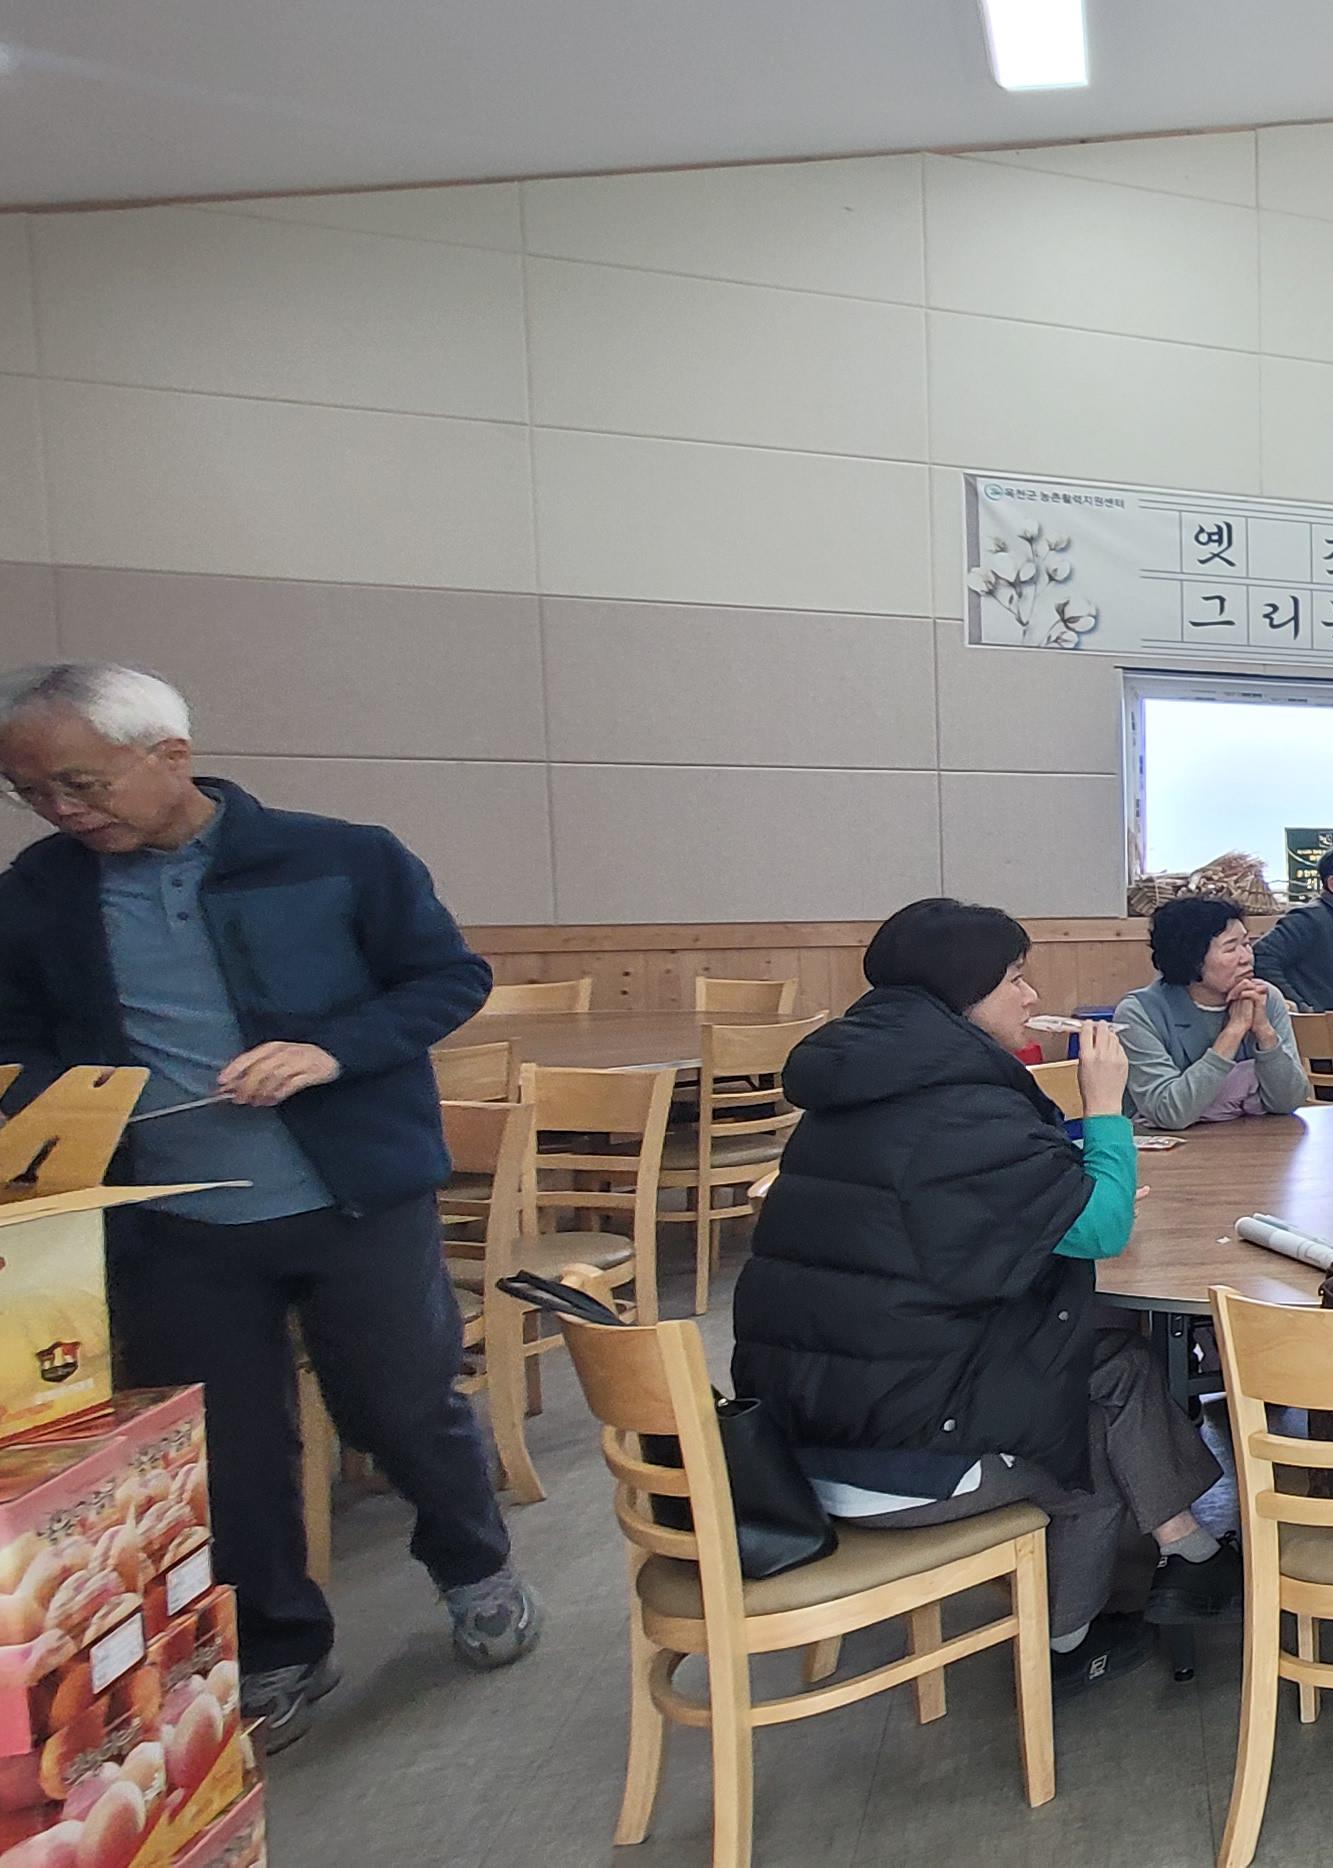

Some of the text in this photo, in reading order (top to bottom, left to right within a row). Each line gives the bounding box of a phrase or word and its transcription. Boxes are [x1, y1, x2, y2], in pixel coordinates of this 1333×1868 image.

[1004, 487, 1126, 509] 옥천군 농촌활력지원센터
[1194, 520, 1237, 567] 옛
